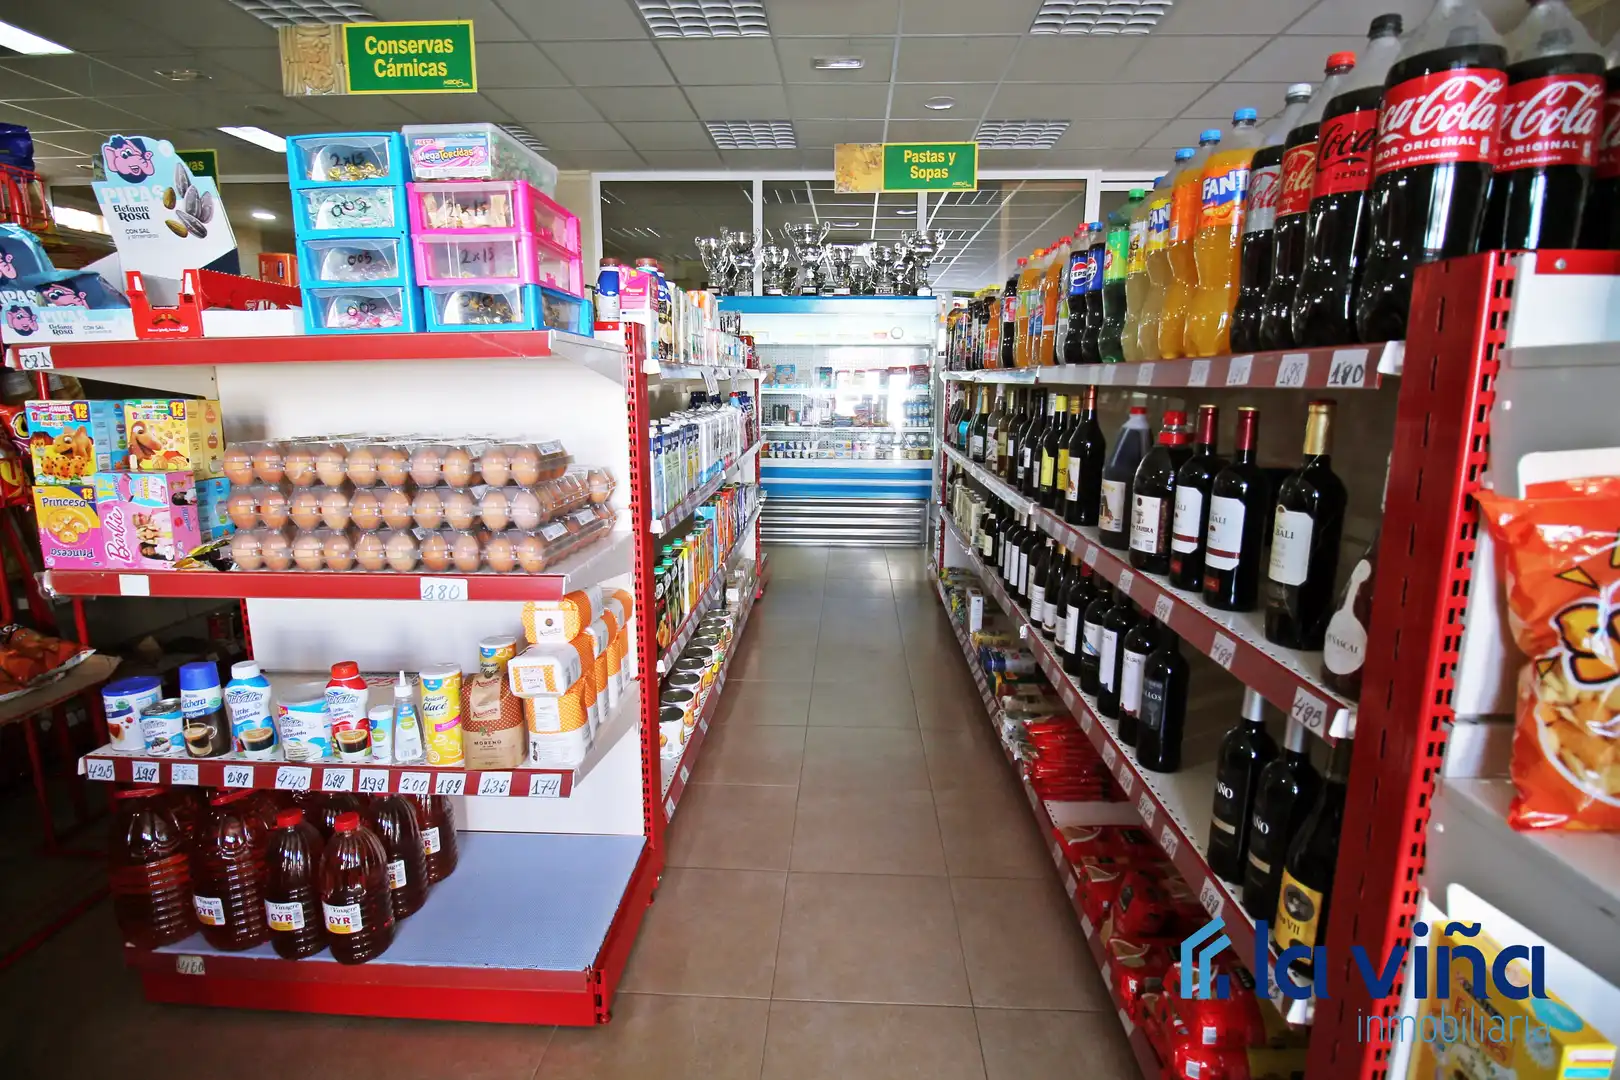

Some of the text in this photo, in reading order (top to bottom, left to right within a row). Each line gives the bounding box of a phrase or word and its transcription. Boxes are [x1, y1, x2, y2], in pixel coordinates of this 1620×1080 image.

[364, 35, 454, 55] Conservas
[373, 57, 448, 78] Cárnicas
[1403, 134, 1477, 153] ORIGINAL
[1503, 140, 1579, 157] ORIGINAL
[903, 150, 957, 166] Pastas y
[910, 165, 949, 182] Sopas
[112, 204, 150, 213] Elefante
[117, 212, 151, 223] Rosa
[42, 497, 87, 507] Princesa
[104, 505, 132, 563] Barbie
[273, 902, 301, 911] Vinagre
[331, 905, 357, 915] Vinagre
[271, 913, 293, 922] GYR
[329, 916, 351, 925] GYR
